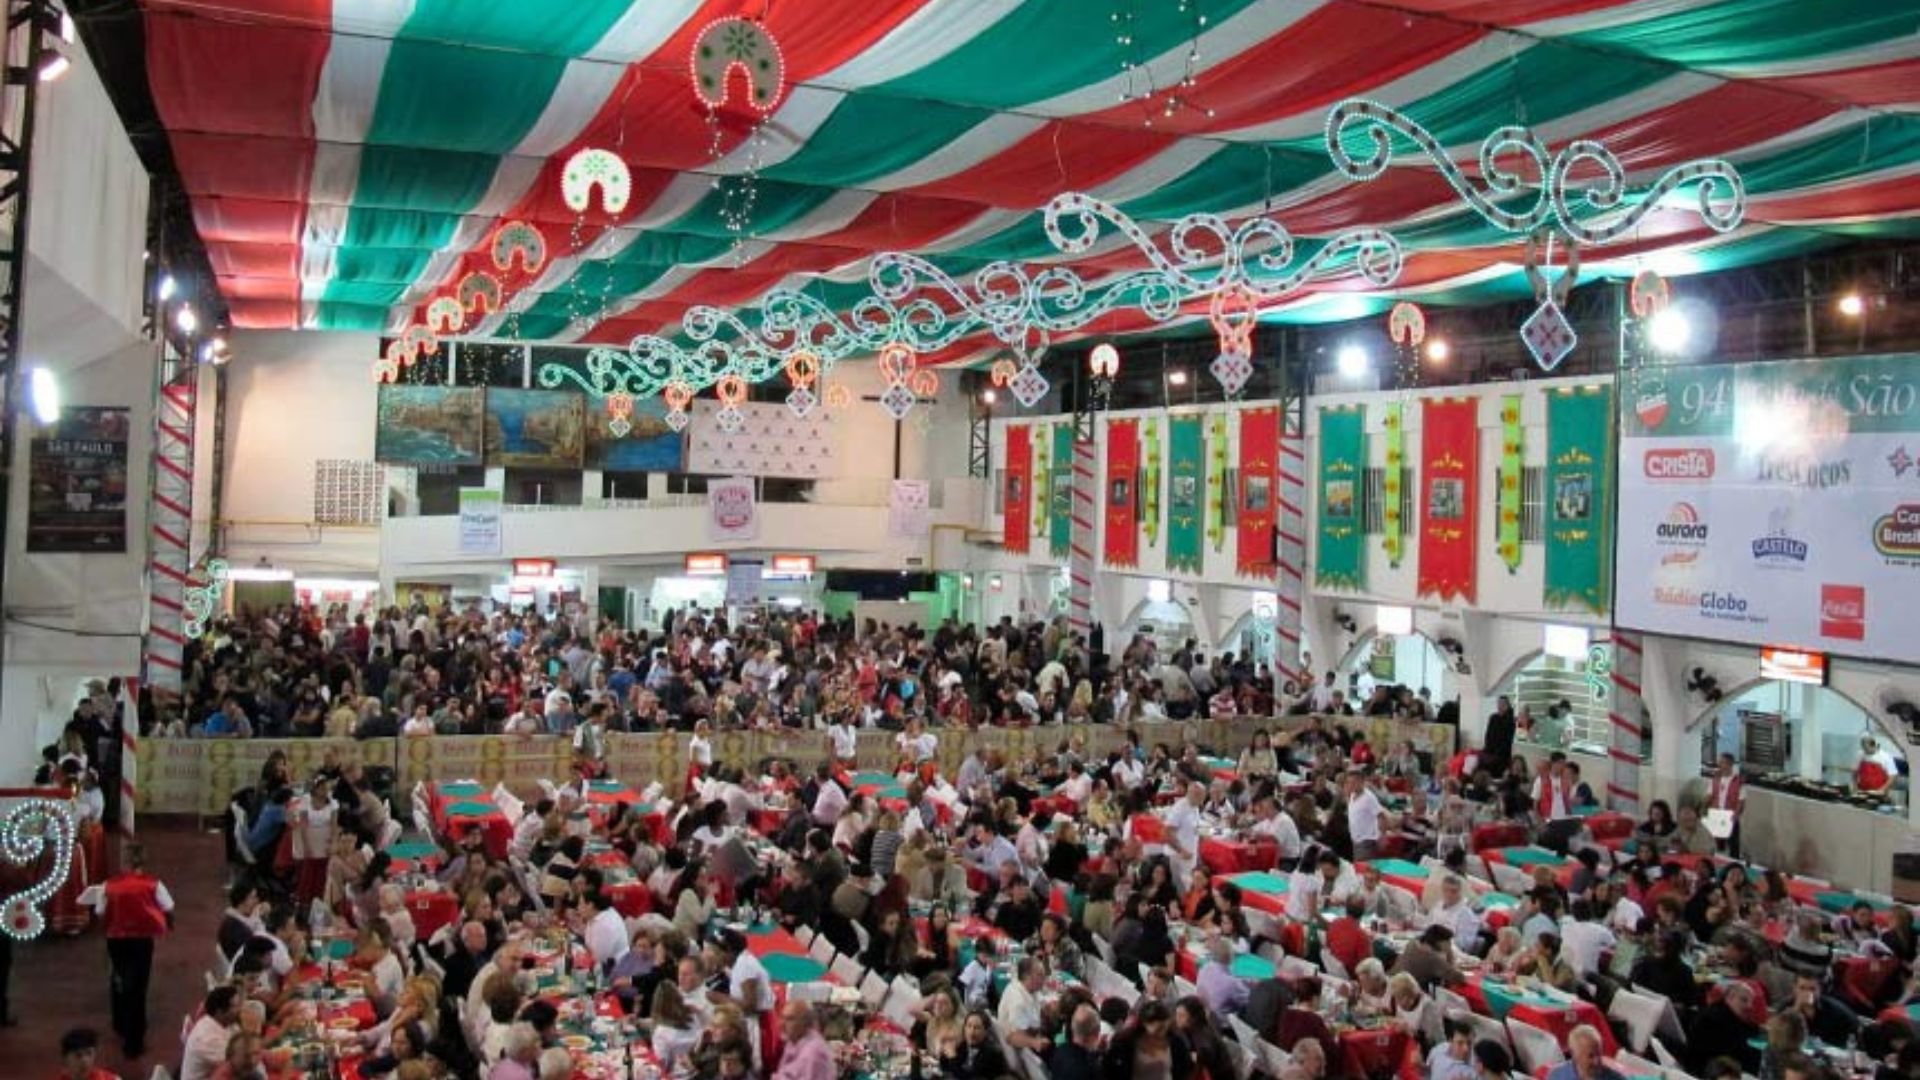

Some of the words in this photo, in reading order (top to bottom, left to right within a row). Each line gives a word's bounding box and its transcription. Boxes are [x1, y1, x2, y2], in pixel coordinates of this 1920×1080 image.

[1844, 373, 1916, 418] São
[73, 442, 113, 455] PAULO
[1896, 509, 1920, 526] Ca
[1656, 523, 1708, 540] aurora
[1754, 538, 1806, 560] CASTELO
